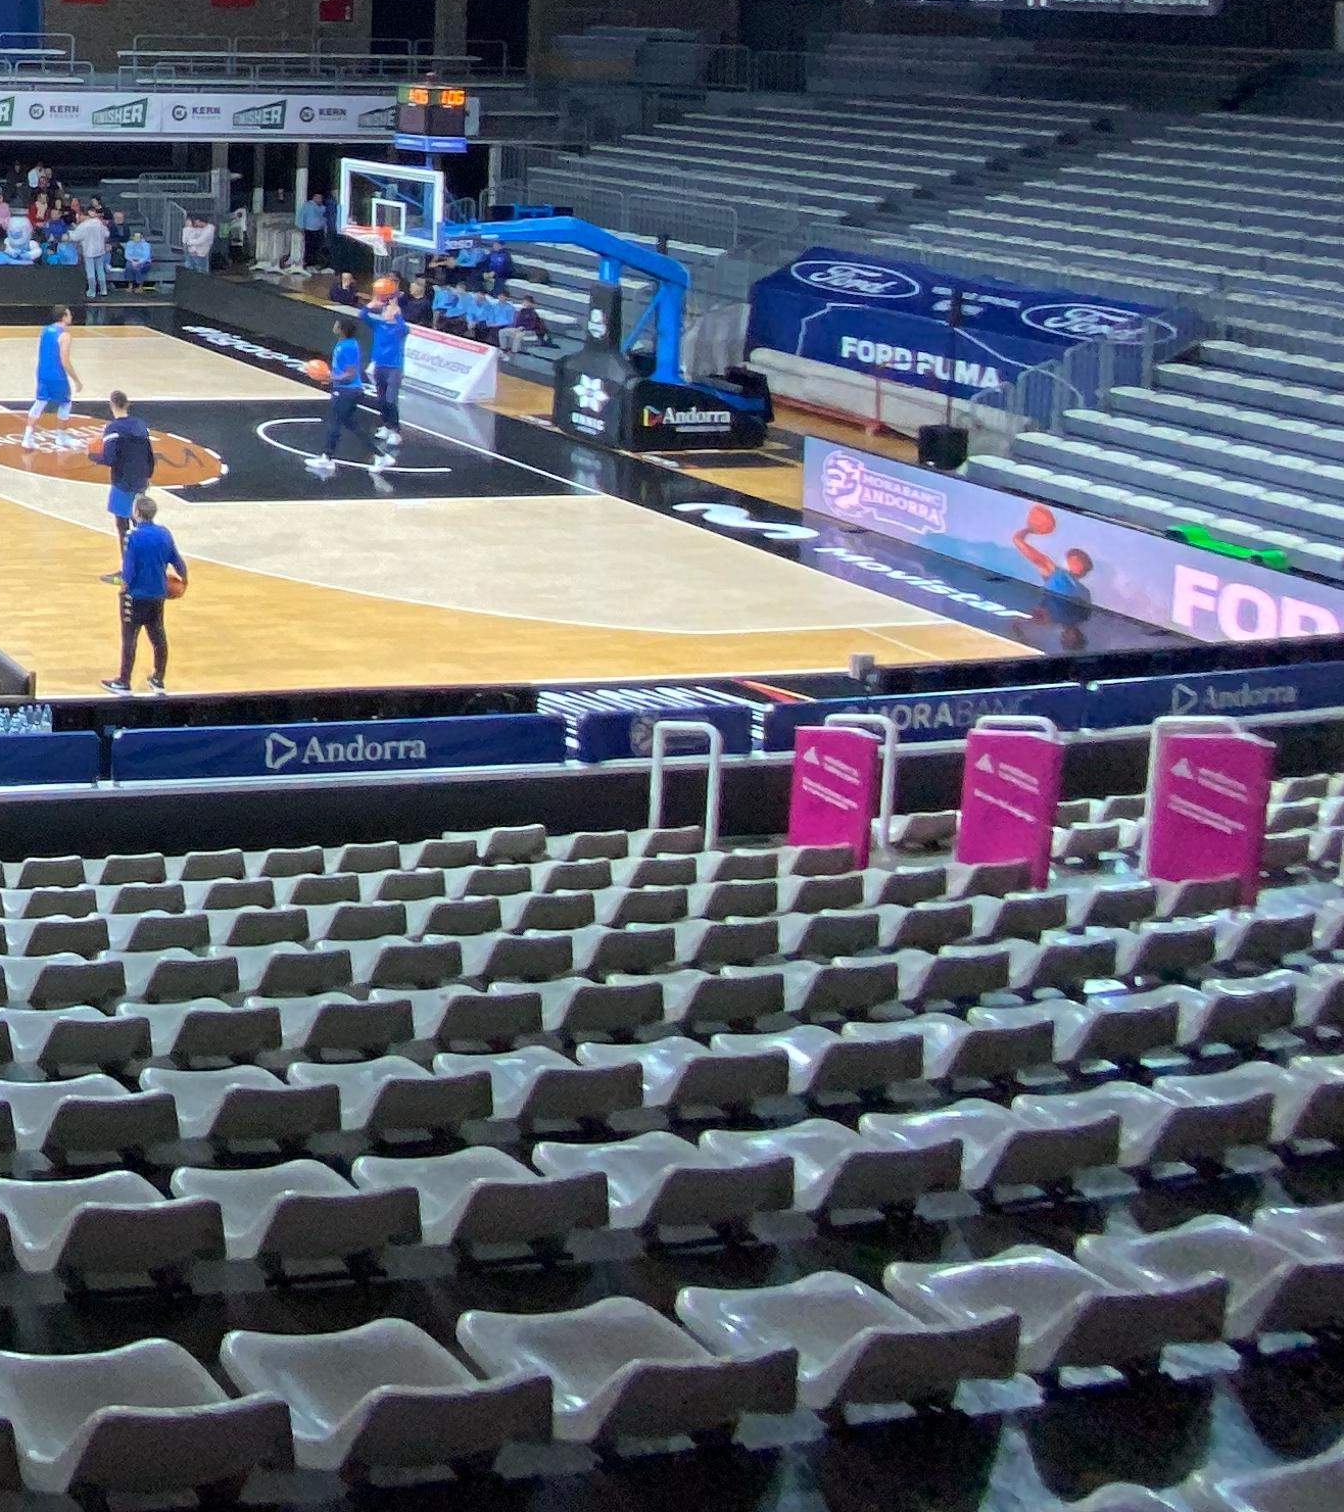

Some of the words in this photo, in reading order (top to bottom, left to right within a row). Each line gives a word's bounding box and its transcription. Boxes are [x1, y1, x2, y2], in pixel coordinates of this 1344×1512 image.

[49, 105, 80, 114] KERN
[191, 106, 221, 115] KERN
[318, 107, 347, 117] KERN
[810, 264, 902, 297] Ford
[841, 336, 911, 376] FORD
[662, 406, 732, 425] Andorra
[862, 487, 941, 528] ANDORRA
[301, 733, 427, 766] Andorra
